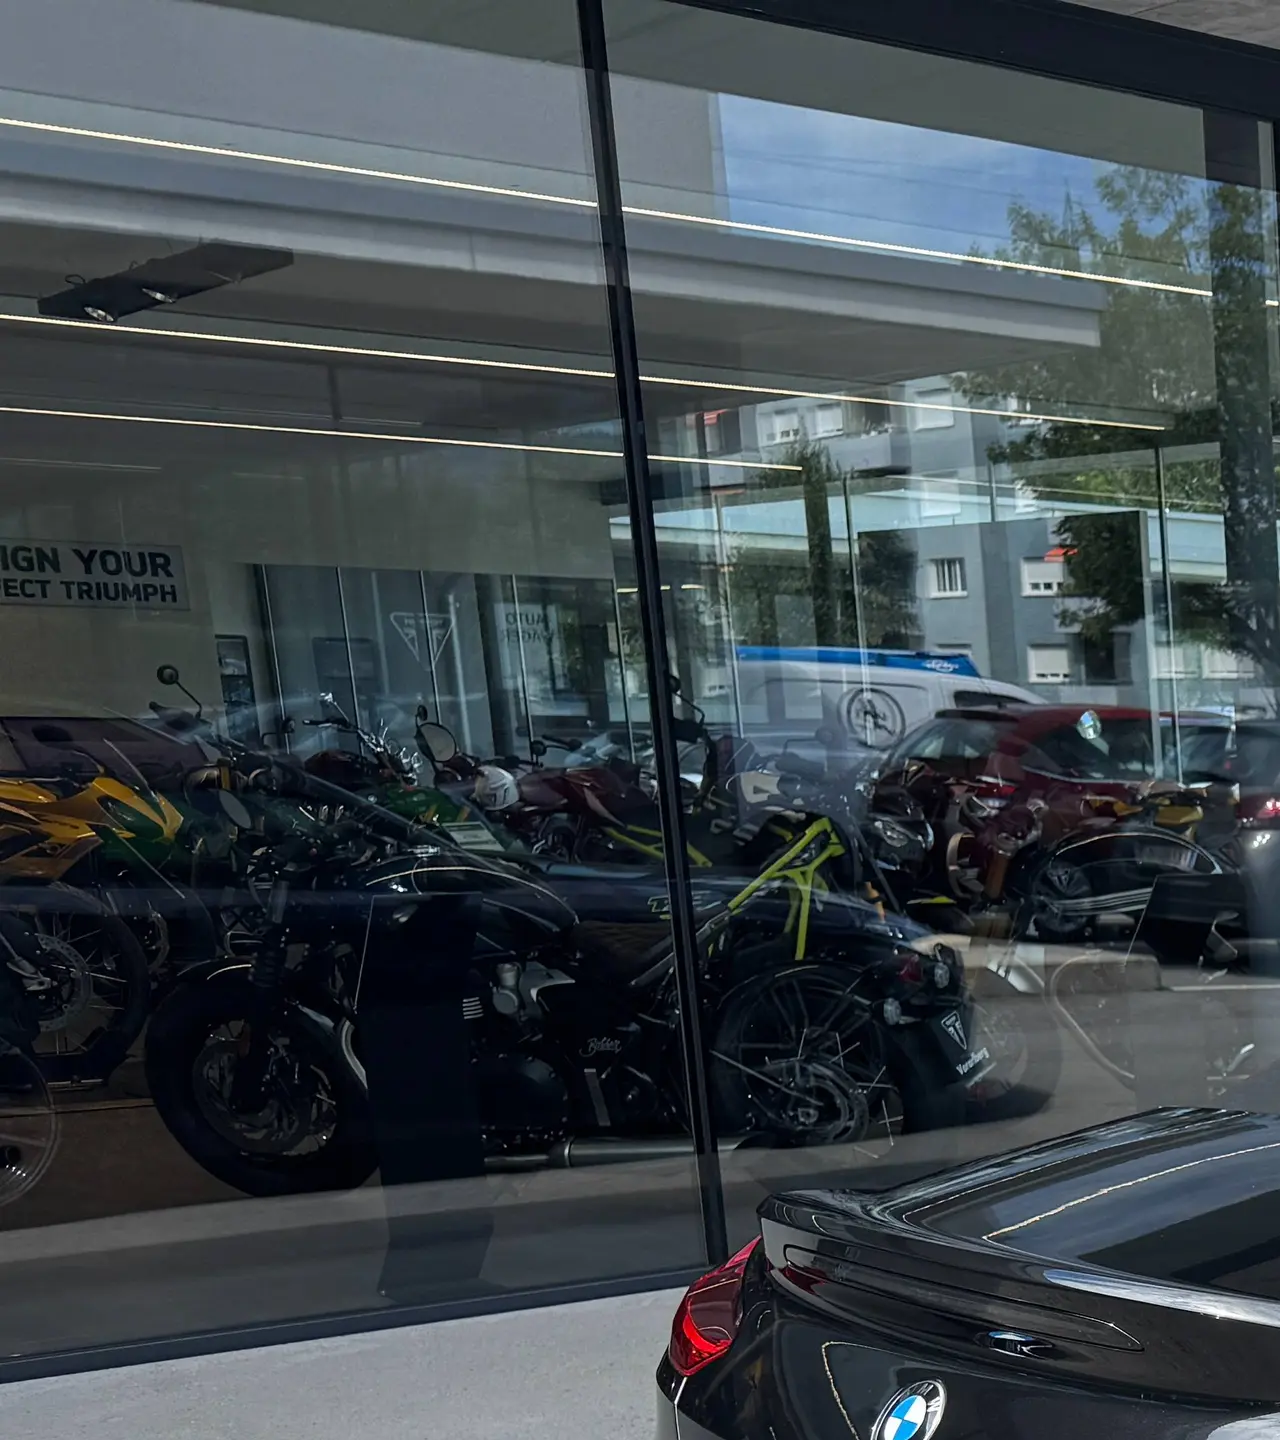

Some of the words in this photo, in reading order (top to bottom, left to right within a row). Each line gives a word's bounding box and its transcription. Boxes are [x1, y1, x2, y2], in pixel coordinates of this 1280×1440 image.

[72, 548, 174, 578] YOUR
[0, 578, 51, 598] ECT
[60, 581, 178, 603] TRIUMPH
